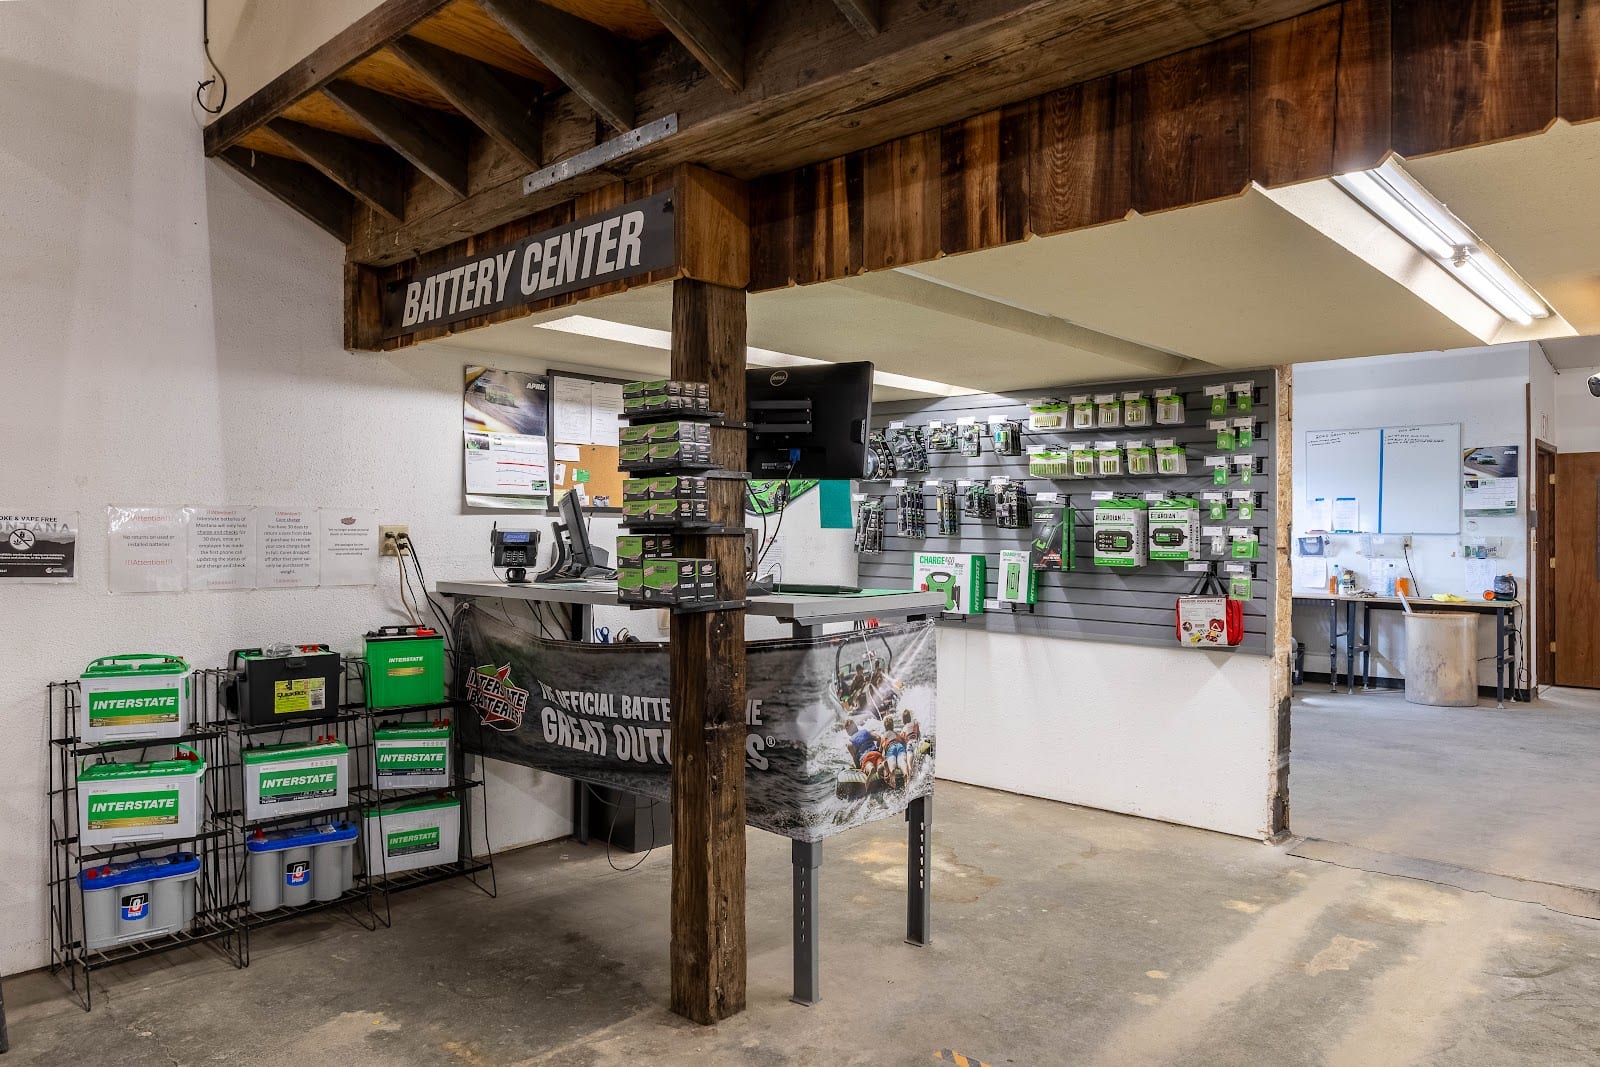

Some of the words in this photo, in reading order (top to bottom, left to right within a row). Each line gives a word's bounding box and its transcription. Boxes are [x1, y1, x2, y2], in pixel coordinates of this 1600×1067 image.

[402, 249, 515, 328] BATTERY
[520, 210, 645, 296] CENTER
[526, 382, 546, 391] APRIL
[919, 555, 945, 565] CHARGE
[388, 655, 424, 663] INTERSTATE
[93, 696, 176, 710] INTERSTATE
[555, 689, 618, 718] OFFICIAL
[621, 694, 671, 722] BATTE
[541, 706, 608, 756] GREAT
[379, 753, 444, 763] INTERSTATE
[262, 773, 335, 789] INTERSTATE
[91, 798, 176, 813] INTERSTATE
[389, 831, 438, 845] INTERSTATE
